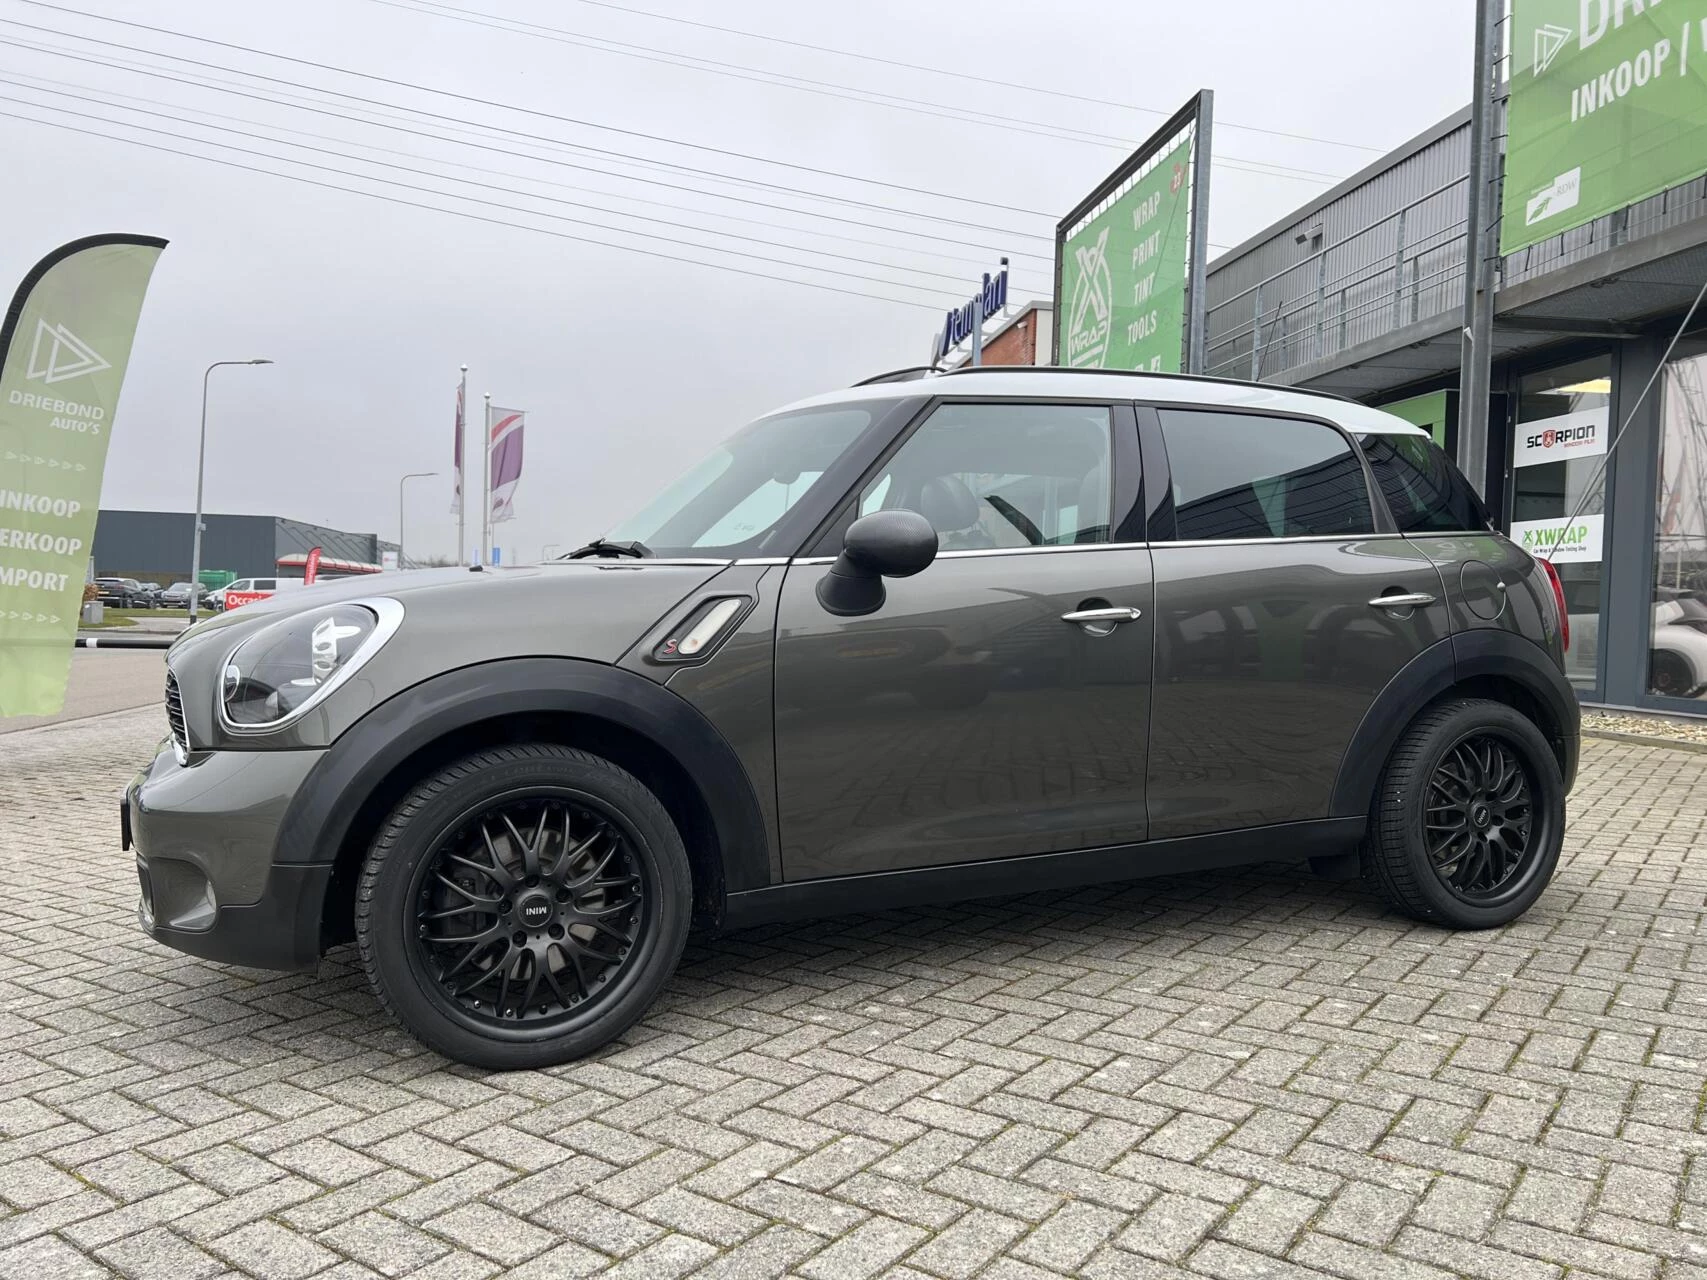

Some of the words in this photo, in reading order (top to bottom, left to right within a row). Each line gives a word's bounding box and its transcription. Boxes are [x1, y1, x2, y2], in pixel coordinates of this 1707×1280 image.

[1571, 39, 1671, 122] INKOOP
[1133, 191, 1160, 231] WRAP
[1133, 230, 1160, 270] PRINT
[1134, 271, 1155, 305] TINT
[1071, 320, 1107, 355] WRAP
[1127, 310, 1157, 346] TOOLS
[9, 390, 104, 420] DRIEBOND
[50, 417, 100, 435] AUTO'S
[0, 489, 81, 518] INKOOP
[664, 639, 677, 655] S
[525, 906, 547, 916] MINI
